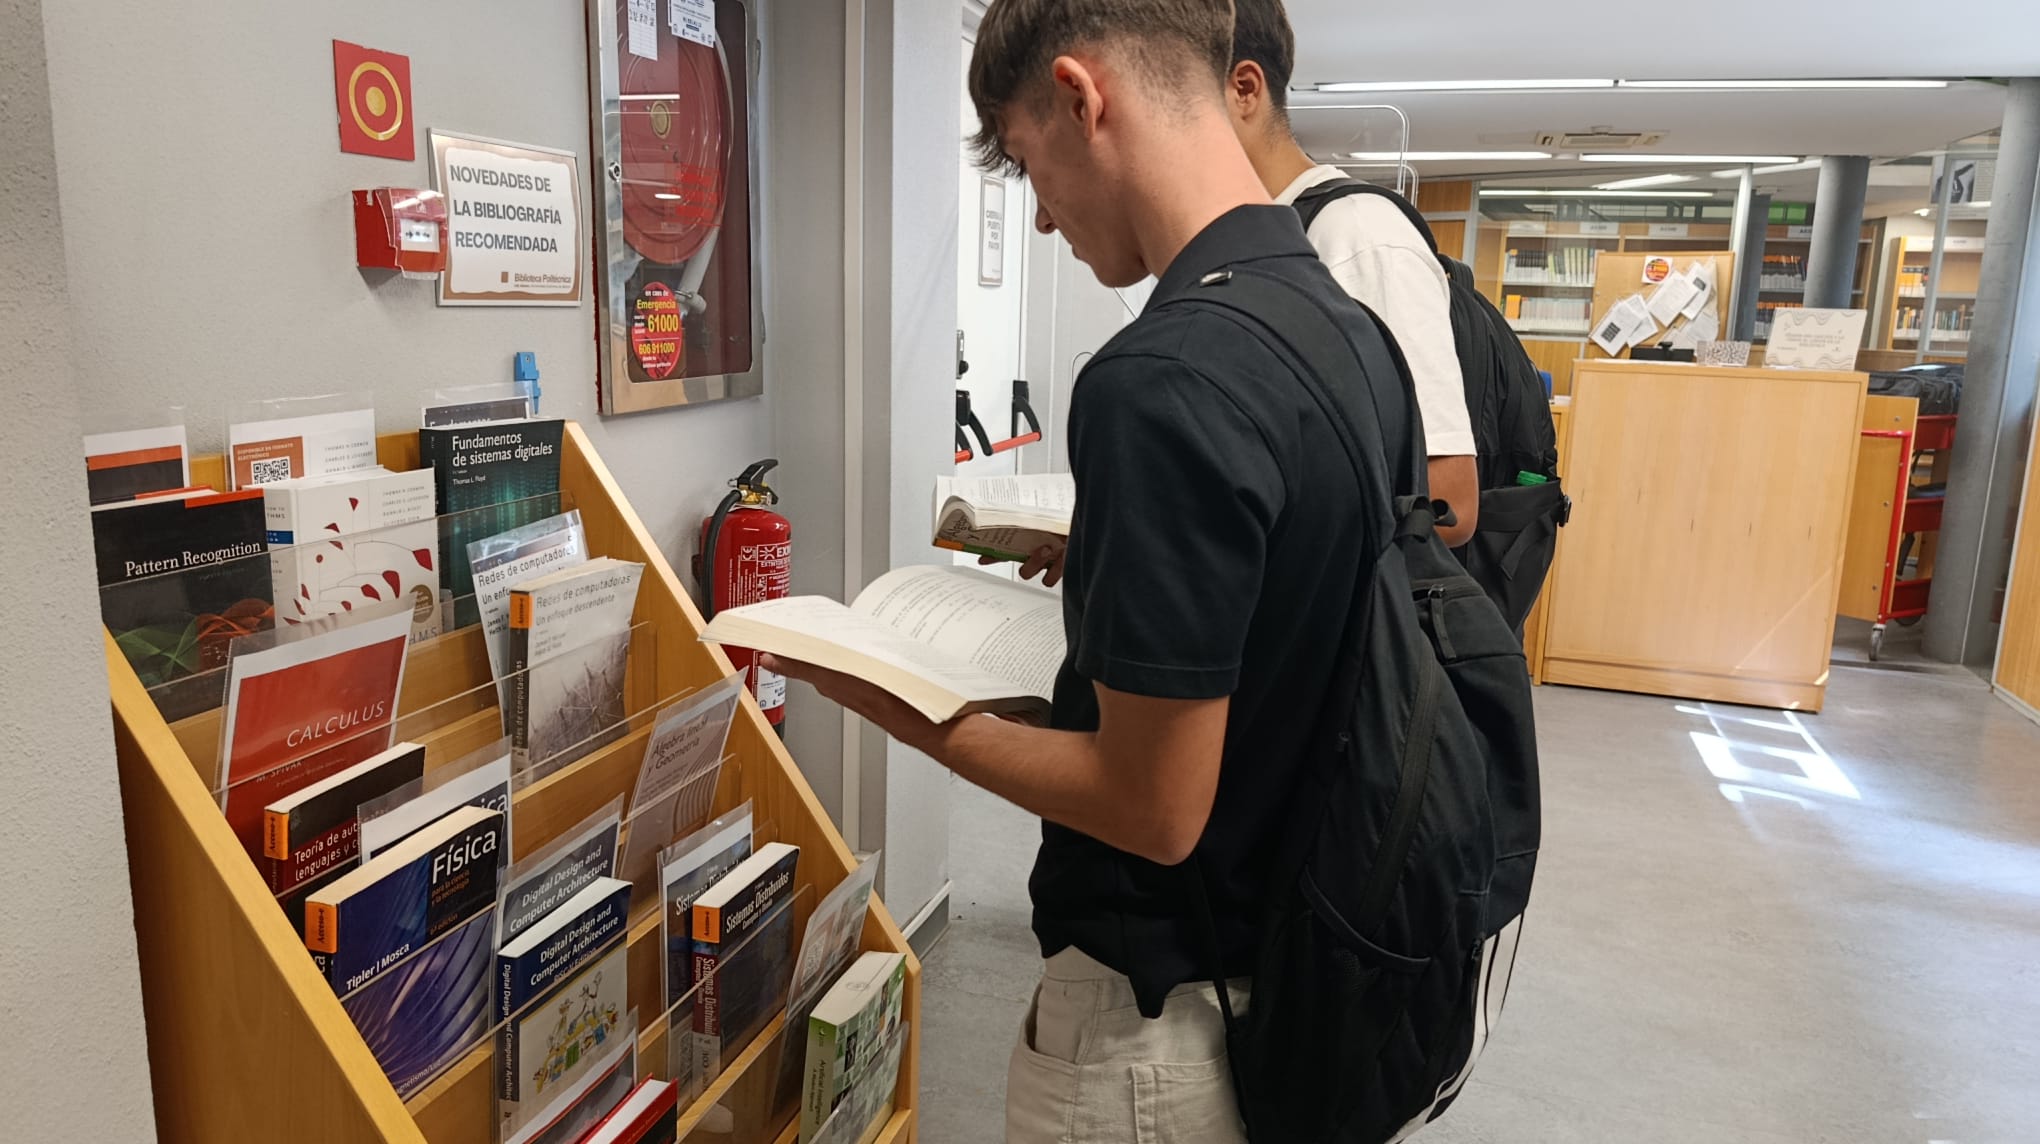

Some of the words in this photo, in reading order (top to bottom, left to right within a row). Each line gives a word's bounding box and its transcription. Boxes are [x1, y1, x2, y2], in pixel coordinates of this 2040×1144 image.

[450, 165, 533, 191] NOVEDADES
[535, 177, 551, 192] DE
[454, 200, 471, 217] LA
[474, 202, 561, 224] BIBLIOGRAFÍA
[455, 231, 558, 252] RECOMENDADA
[515, 273, 541, 282] Biblioteca
[637, 299, 676, 311] Emergencia
[648, 314, 678, 332] 61000
[452, 433, 522, 450] Fundamentos
[453, 453, 467, 467] de
[470, 449, 512, 465] sistemas
[515, 442, 552, 461] digitales
[125, 557, 179, 577] Pattern
[182, 543, 261, 565] Recognition
[478, 570, 505, 587] Redes
[507, 564, 518, 577] de
[563, 587, 573, 601] de
[575, 574, 631, 599] computadoras
[482, 591, 492, 605] Un
[536, 615, 546, 626] Un
[547, 606, 573, 623] enfoque
[575, 594, 615, 613] descendente
[287, 701, 385, 747] CALCULUS
[294, 840, 324, 864] Teoría
[327, 833, 338, 847] de
[295, 848, 340, 881] lenguajes
[344, 843, 349, 856] y
[432, 829, 496, 884] Física
[522, 879, 553, 907] Digital
[554, 859, 584, 885] Design
[585, 844, 602, 864] and
[510, 901, 554, 932] Computer
[556, 859, 608, 901] Architecture
[726, 898, 754, 934] Sistemas
[755, 872, 789, 907] Distribuidos
[540, 935, 568, 963] Digital
[569, 918, 595, 942] Design
[597, 904, 612, 922] and
[530, 952, 571, 986] Computer
[572, 916, 618, 954] Architecture
[346, 966, 374, 991] Tipler
[381, 943, 410, 968] Mosca
[502, 964, 511, 989] Digital
[502, 990, 511, 1016] Design
[504, 1017, 512, 1031] nd
[504, 1031, 513, 1067] Computer
[815, 1088, 824, 1125] Intelligence
